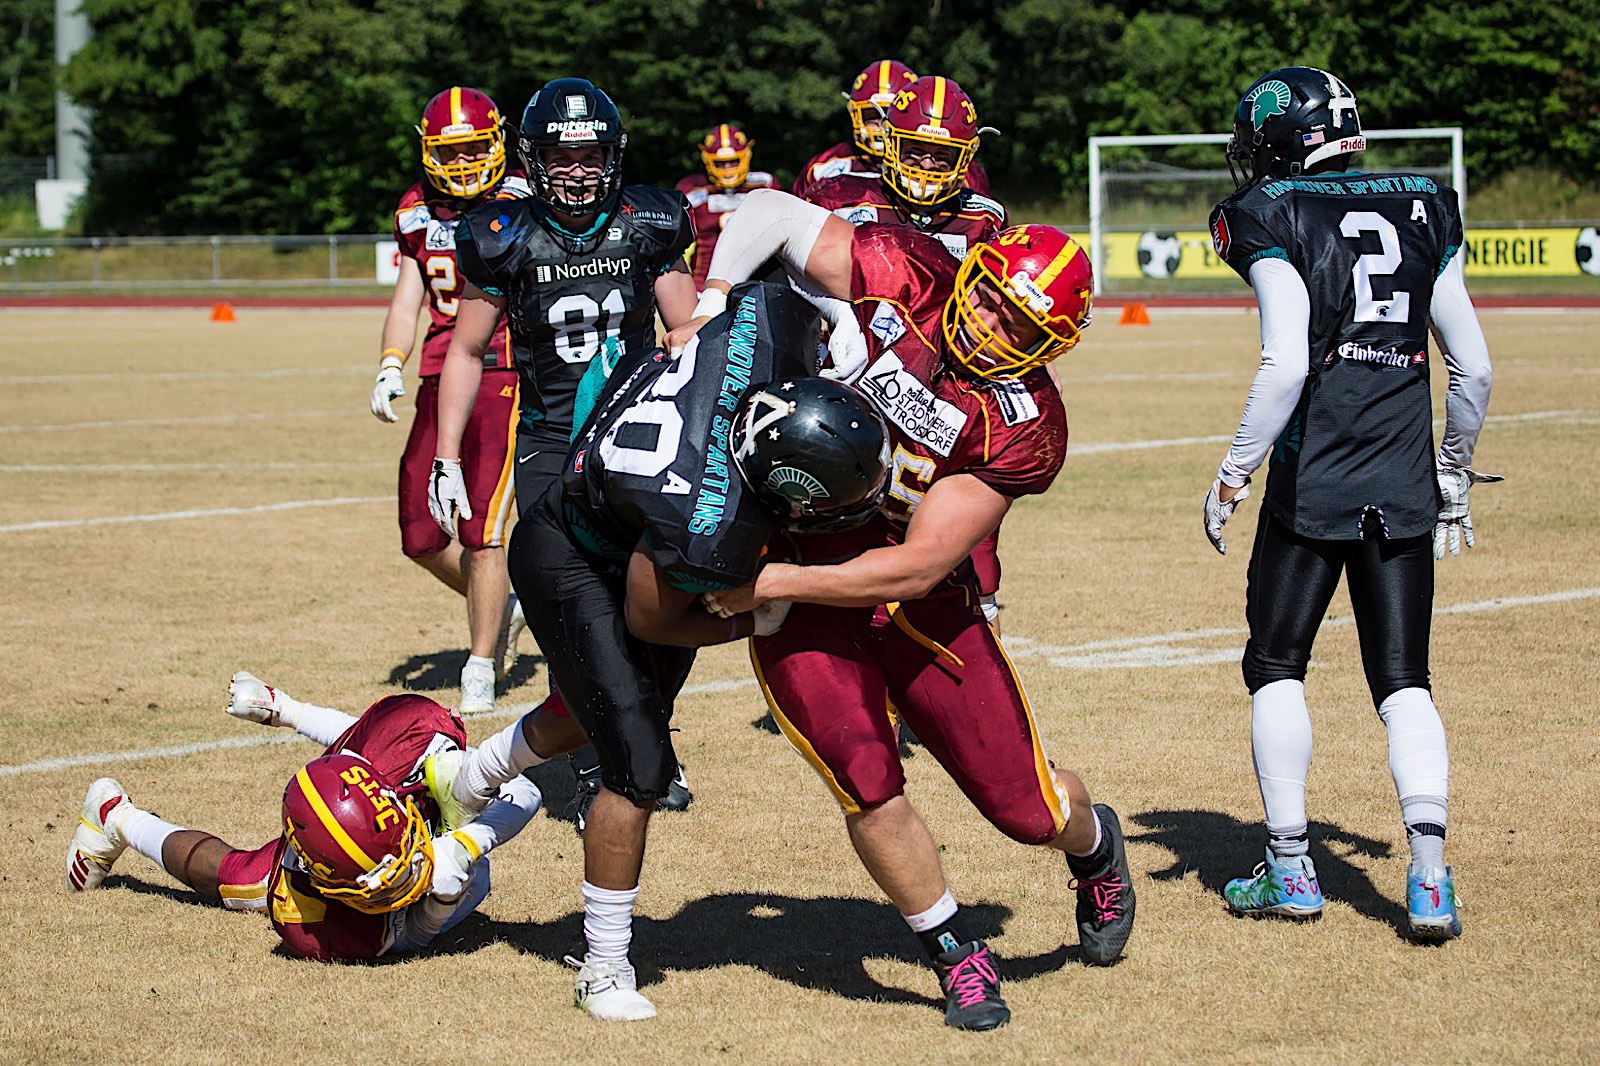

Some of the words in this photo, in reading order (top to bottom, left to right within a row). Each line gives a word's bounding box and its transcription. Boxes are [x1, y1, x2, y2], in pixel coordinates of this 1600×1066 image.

[547, 120, 607, 133] Durasin
[1261, 180, 1347, 200] HANNOVER
[1345, 176, 1438, 195] SPARTANS
[1410, 200, 1428, 224] A
[555, 257, 631, 281] NordHyp
[1339, 211, 1410, 323] 2
[548, 288, 627, 363] 81
[717, 295, 758, 413] HANNOVER
[661, 470, 692, 495] A
[688, 415, 732, 537] SPARTANS
[339, 765, 400, 831] JETS
